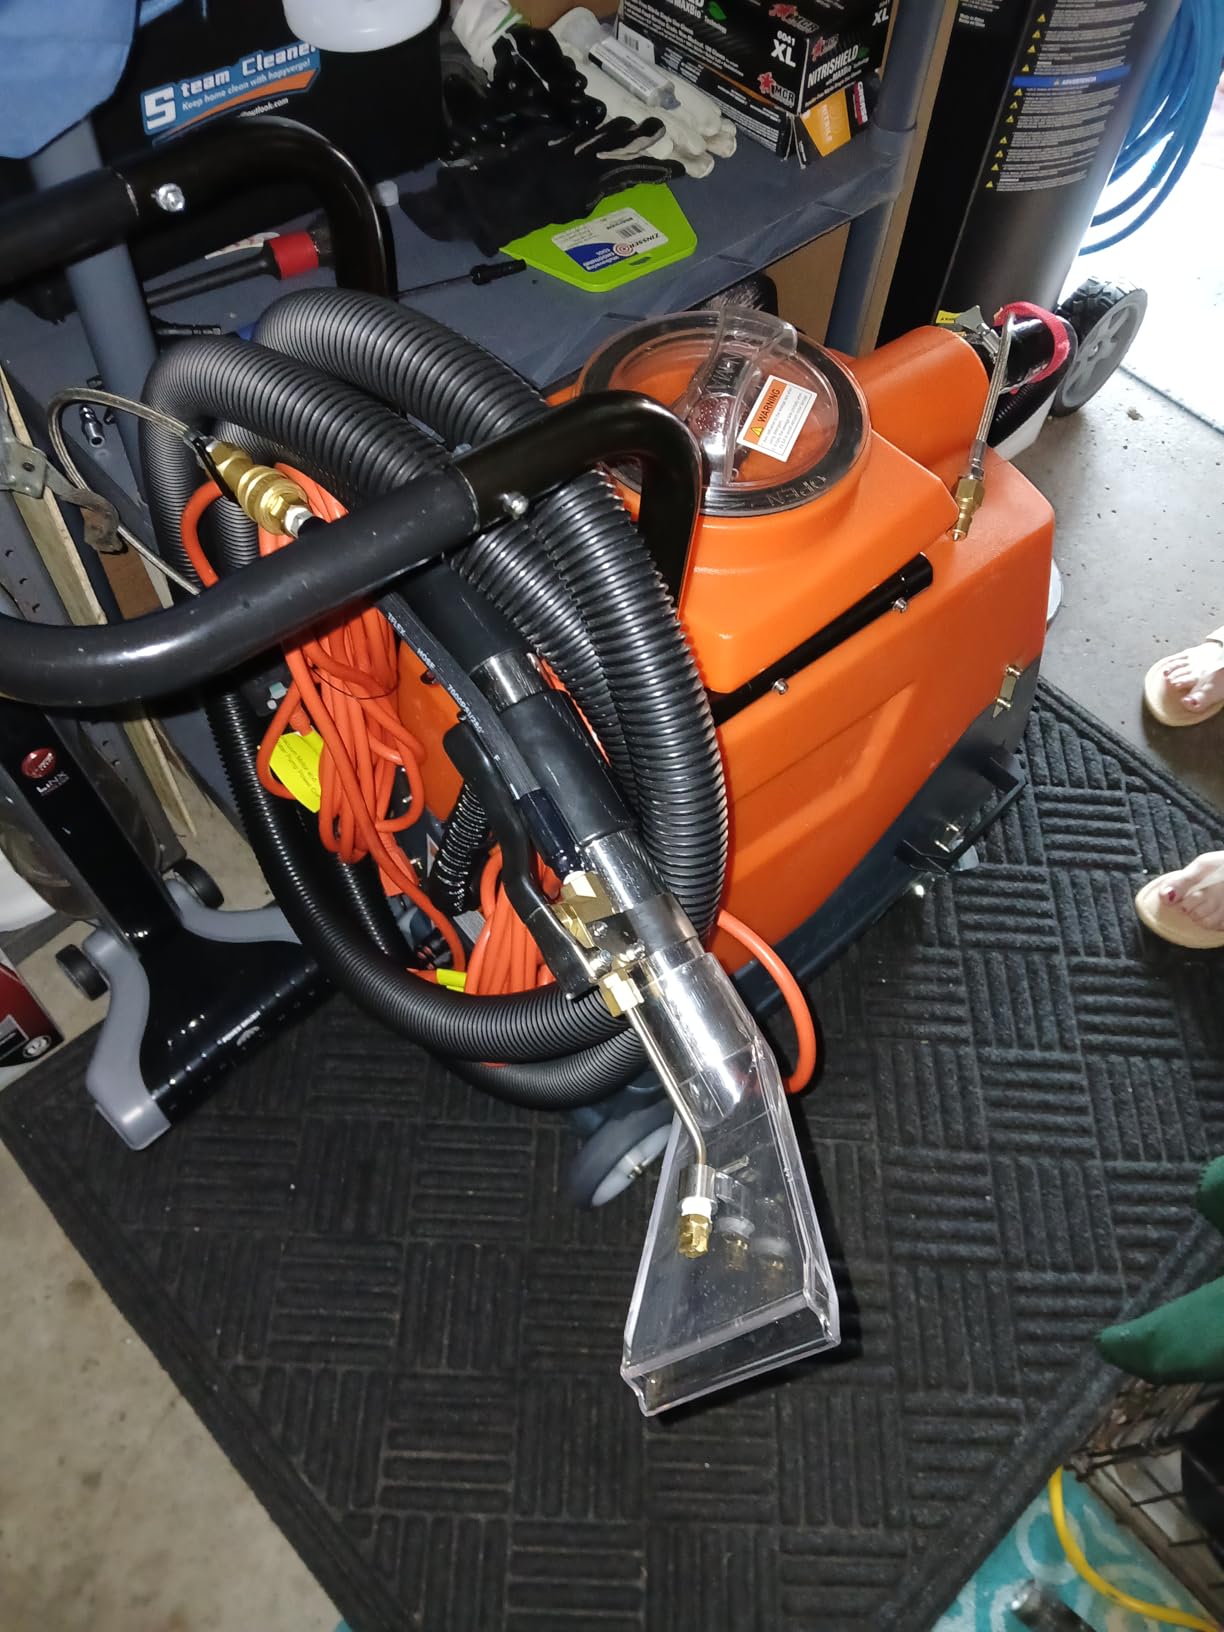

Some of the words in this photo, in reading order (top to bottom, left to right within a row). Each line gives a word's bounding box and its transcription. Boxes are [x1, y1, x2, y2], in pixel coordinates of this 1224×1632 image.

[872, 8, 889, 26] XL
[777, 30, 795, 47] 6041
[771, 39, 796, 68] XL
[807, 45, 858, 88] NITRISHIELD
[182, 98, 203, 111] Keep
[204, 90, 226, 103] home
[227, 80, 249, 95] clean
[774, 84, 795, 102] MCR
[757, 388, 780, 423] WARNING
